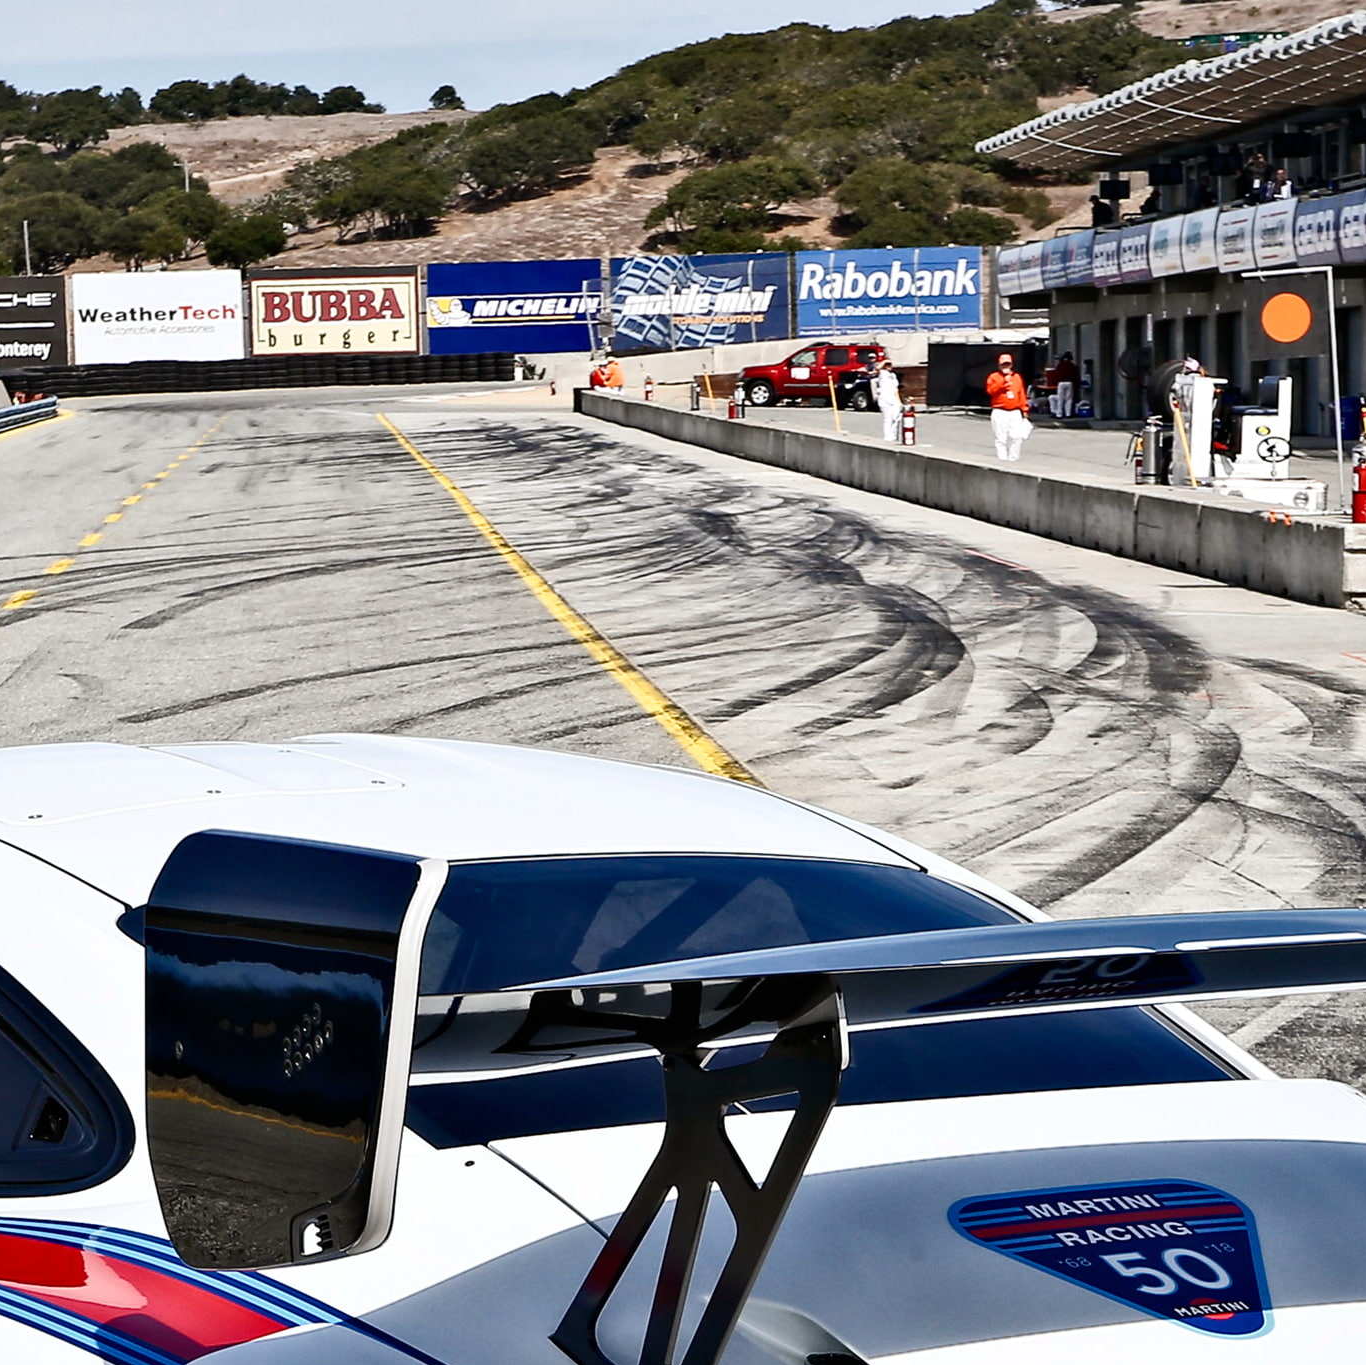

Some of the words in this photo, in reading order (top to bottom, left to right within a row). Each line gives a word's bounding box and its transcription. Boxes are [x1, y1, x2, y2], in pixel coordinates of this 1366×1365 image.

[799, 258, 979, 300] Rabobank
[261, 288, 405, 323] BUBBA
[472, 297, 601, 317] MICHELIN
[622, 284, 710, 315] mobile
[712, 285, 779, 314] mini
[78, 304, 236, 323] WeatherTech
[268, 328, 400, 349] burger
[1025, 1194, 1161, 1219] MARTINI
[1056, 1221, 1193, 1247] RACING
[1099, 1248, 1234, 1295] 50
[1174, 1301, 1250, 1317] MARTINI
